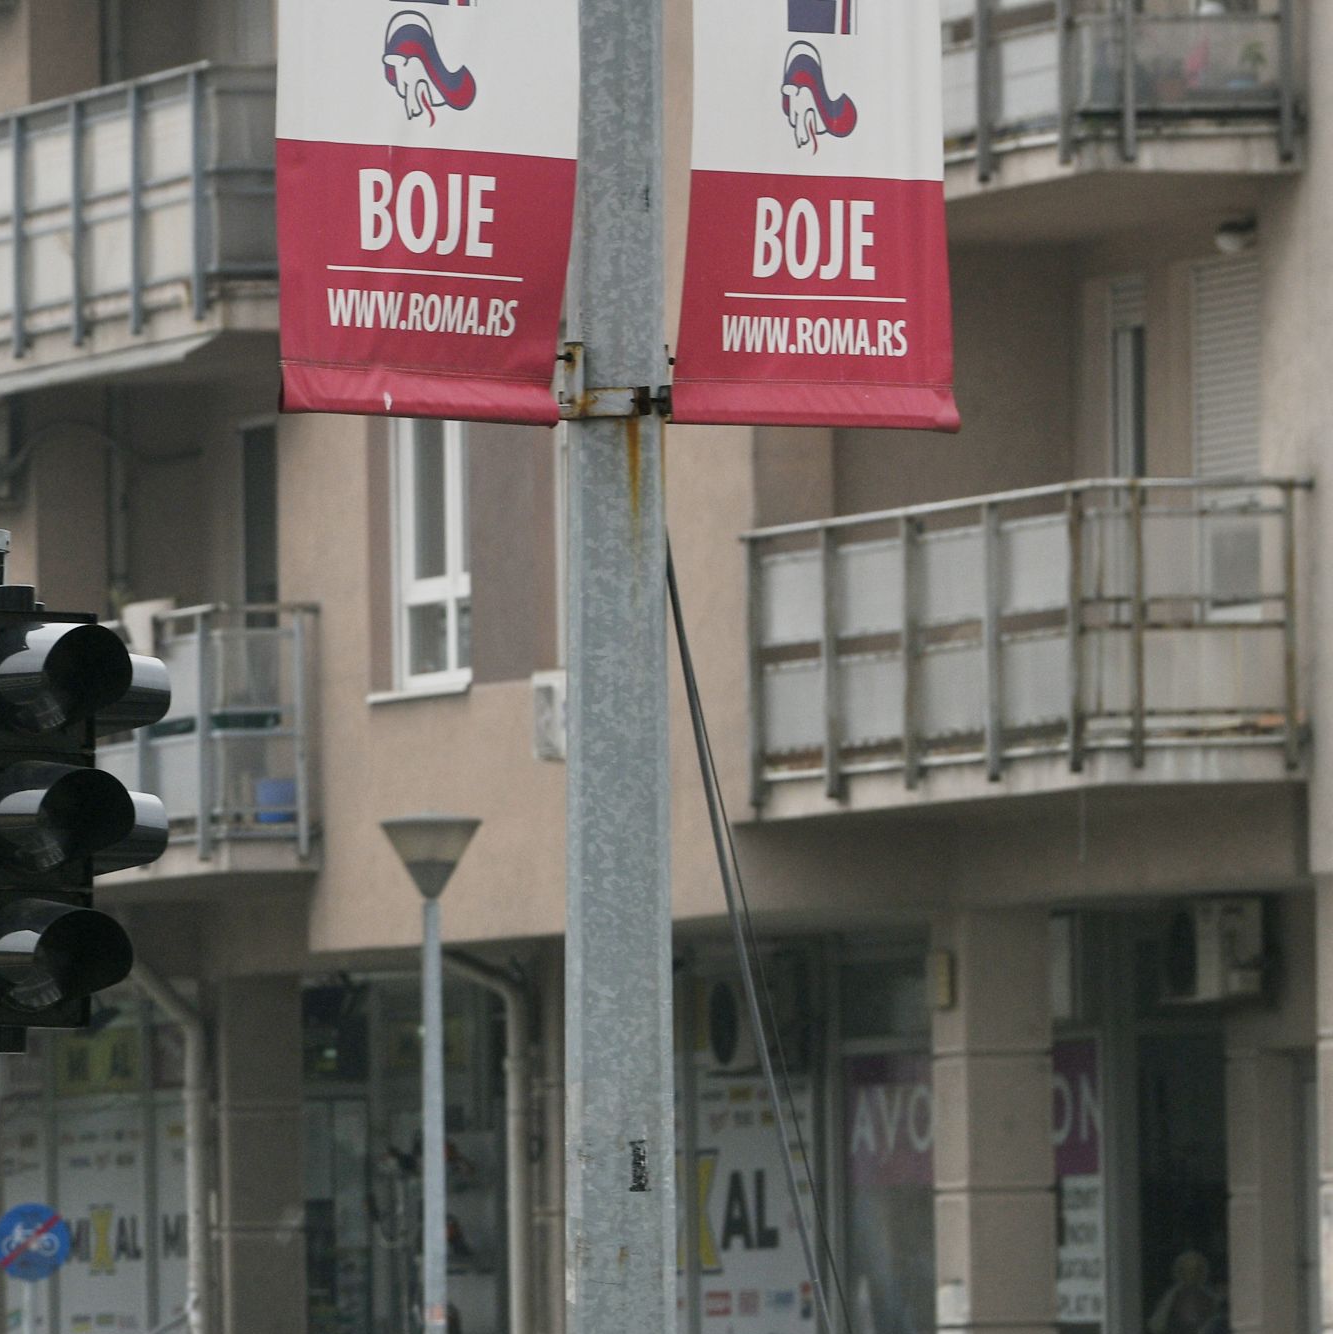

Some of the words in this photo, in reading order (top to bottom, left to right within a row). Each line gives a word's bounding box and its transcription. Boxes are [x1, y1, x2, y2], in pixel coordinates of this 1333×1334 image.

[358, 167, 496, 259] BOJE
[752, 197, 876, 281] BOJE
[327, 288, 518, 338] WWW.ROMA.RS
[722, 314, 907, 358] WWW.ROMA.RS
[851, 1084, 933, 1155] AVO
